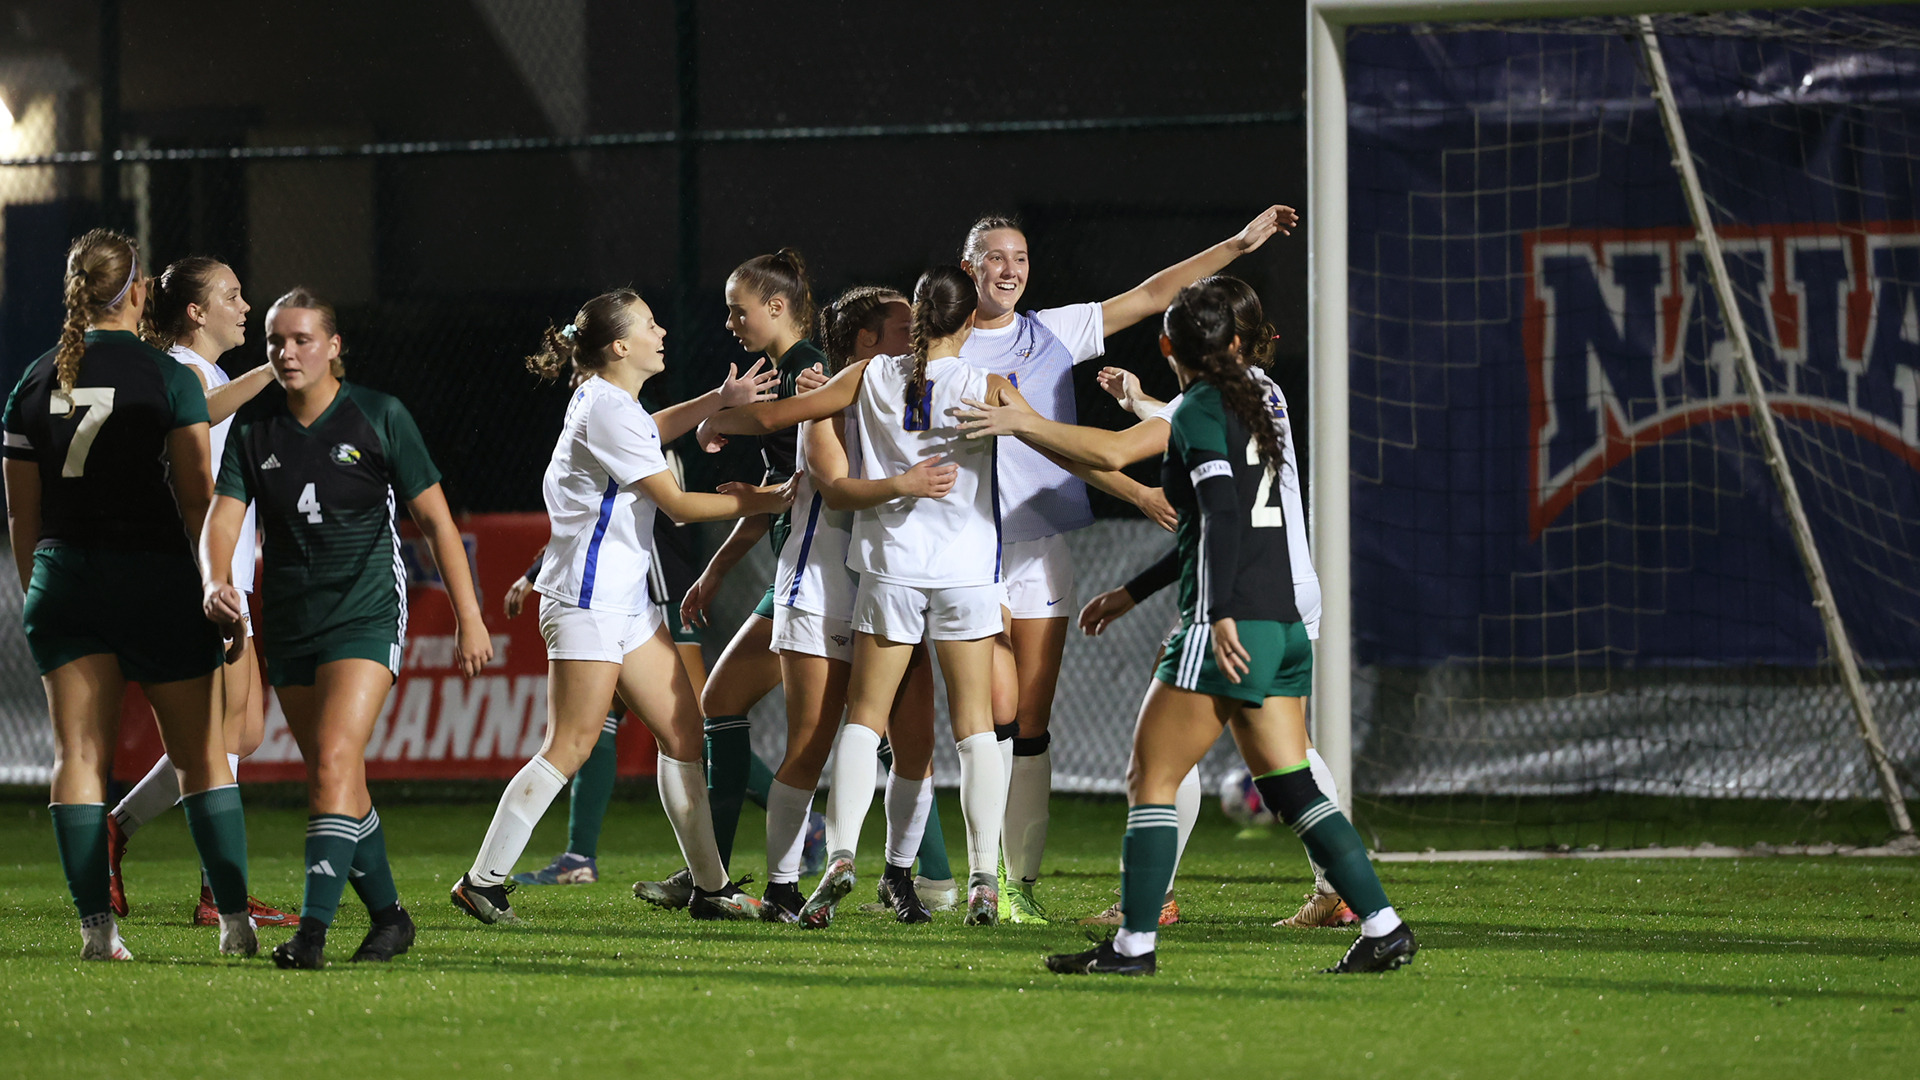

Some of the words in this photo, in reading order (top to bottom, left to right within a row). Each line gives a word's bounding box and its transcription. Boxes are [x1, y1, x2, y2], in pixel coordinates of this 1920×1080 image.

[1531, 237, 1920, 506] NAIA
[50, 387, 115, 478] 7
[297, 482, 323, 524] 4
[1246, 434, 1283, 528] 2
[365, 675, 551, 761] ANNE
